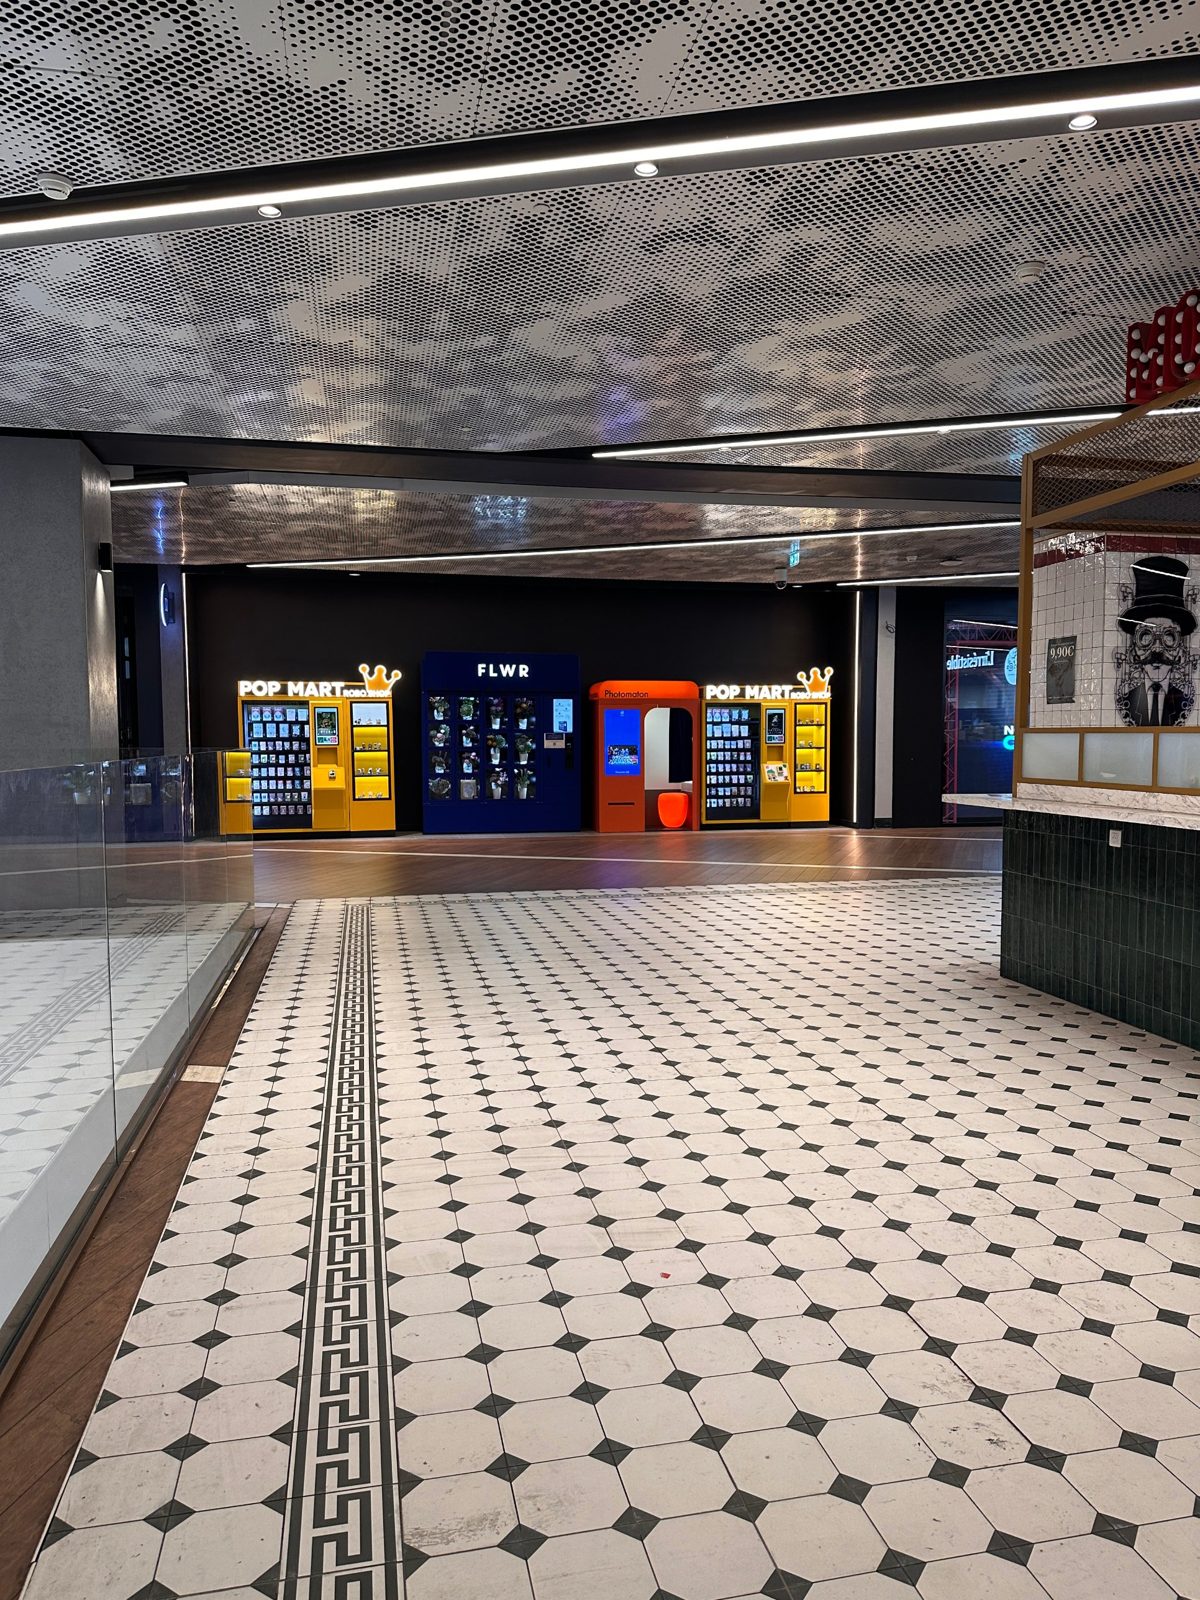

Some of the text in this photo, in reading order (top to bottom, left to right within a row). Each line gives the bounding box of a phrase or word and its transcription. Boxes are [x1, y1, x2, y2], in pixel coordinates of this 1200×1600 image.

[477, 663, 530, 678] FLWR
[238, 680, 345, 698] POP MART
[604, 689, 649, 698] Photomaton
[705, 684, 793, 700] POP MART
